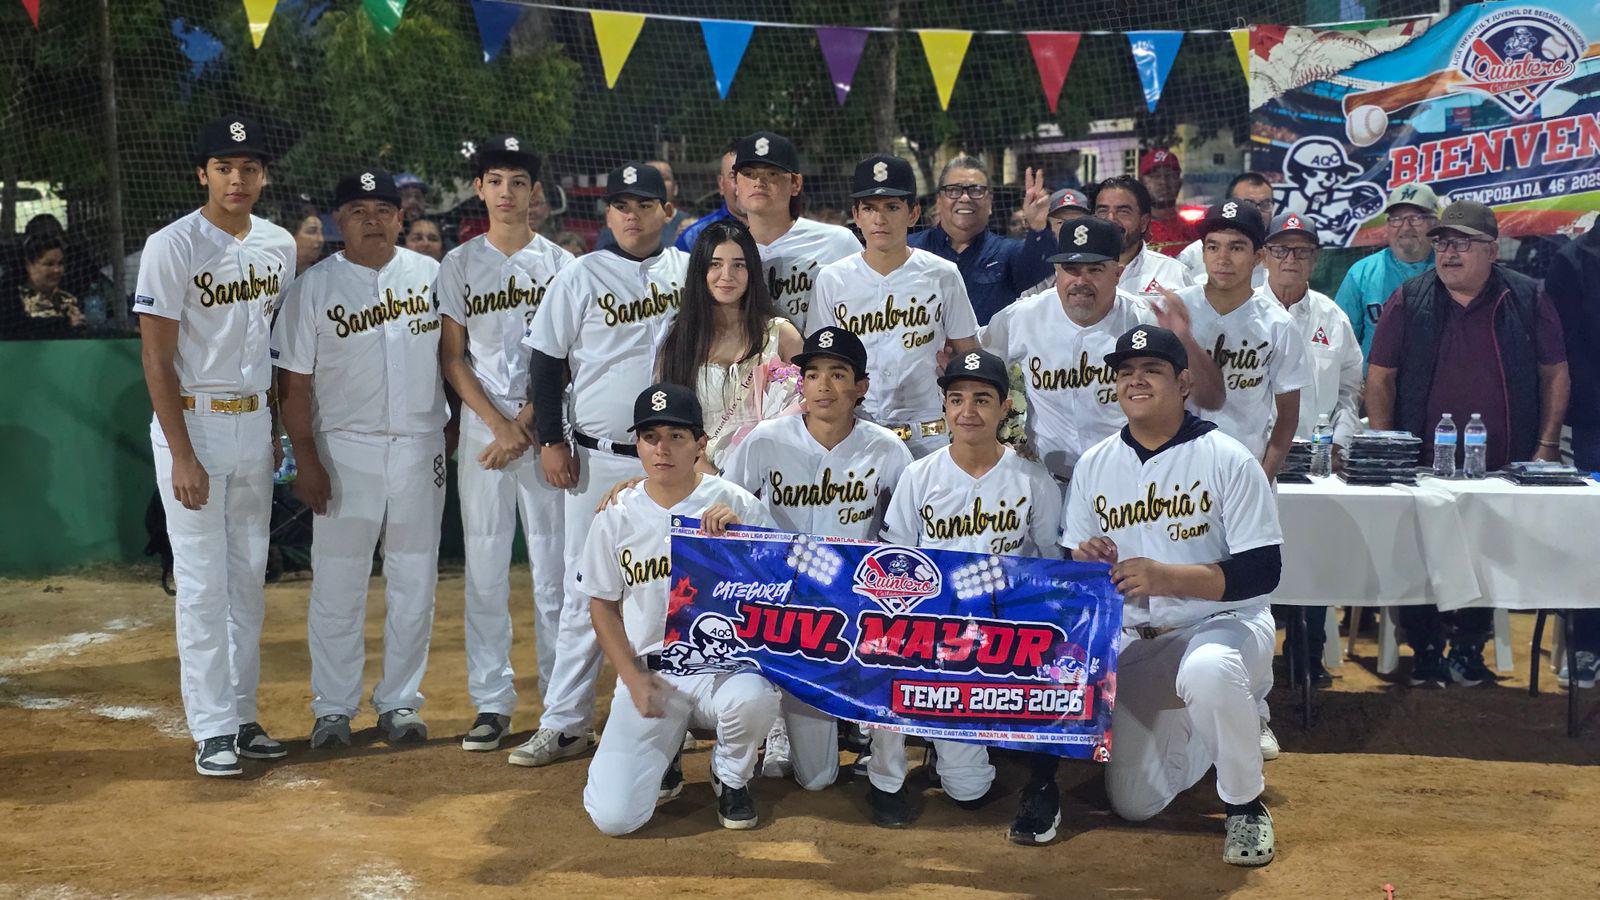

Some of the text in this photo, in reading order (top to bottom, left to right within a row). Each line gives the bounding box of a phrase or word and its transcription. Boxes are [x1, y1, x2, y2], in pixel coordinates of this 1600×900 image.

[1490, 9, 1521, 22] JUVENIL
[1472, 53, 1568, 82] Quintero
[1310, 153, 1340, 167] AQC
[1452, 182, 1542, 205] TEMPORADA
[1548, 178, 1566, 194] 46
[787, 298, 810, 316] Te
[408, 318, 440, 336] Team
[902, 330, 936, 350] Team
[1227, 373, 1264, 391] Team
[1097, 388, 1119, 405] Te
[838, 506, 876, 525] Team
[1167, 522, 1211, 541] Team
[712, 579, 793, 602] CATEGORIA
[866, 570, 933, 592] Quintero
[710, 627, 732, 639] AQC
[734, 603, 1055, 667] JUV. MAYOR
[900, 684, 1085, 714] TEMP. 2025-2026
[915, 727, 942, 737] QUINTERO
